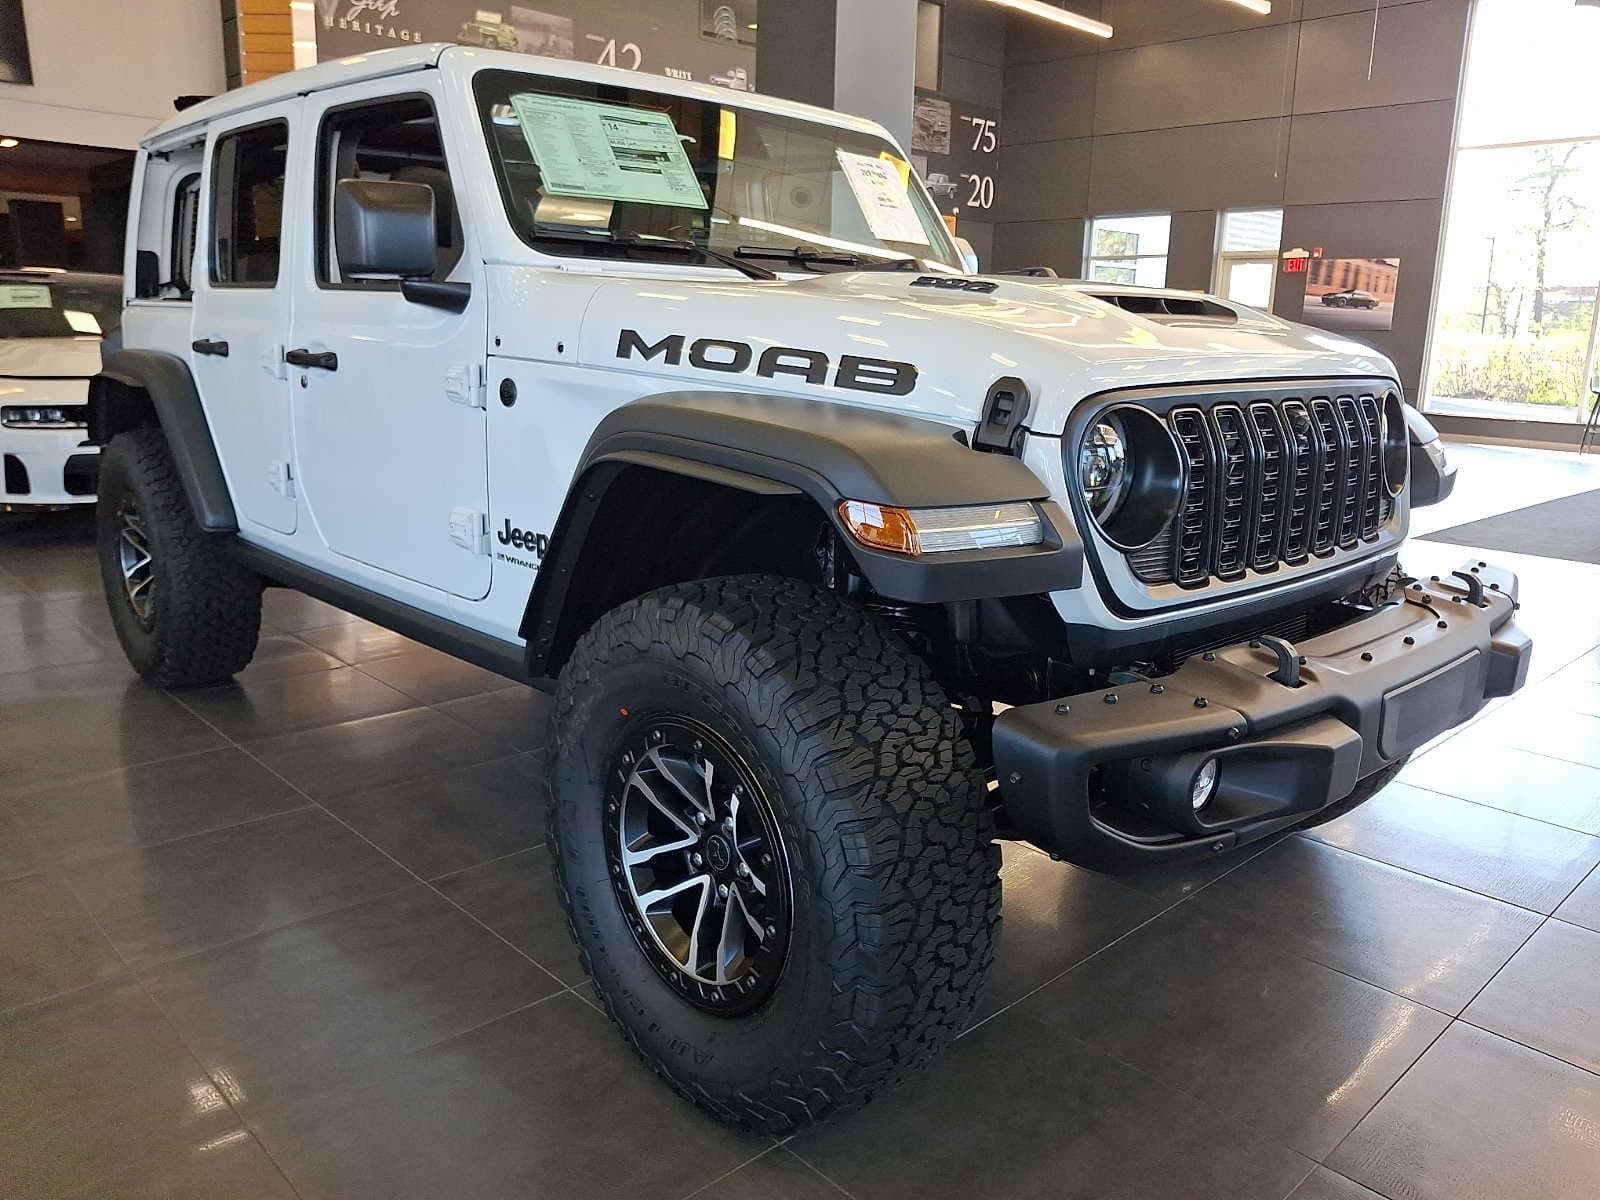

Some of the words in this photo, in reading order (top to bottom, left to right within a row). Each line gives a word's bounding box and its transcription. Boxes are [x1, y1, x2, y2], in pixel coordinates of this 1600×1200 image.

[972, 117, 996, 153] 75
[967, 174, 994, 209] 20
[1287, 258, 1305, 272] EXIT
[616, 328, 919, 396] MOAB
[497, 517, 550, 560] Jeep
[505, 555, 540, 571] WRANG
